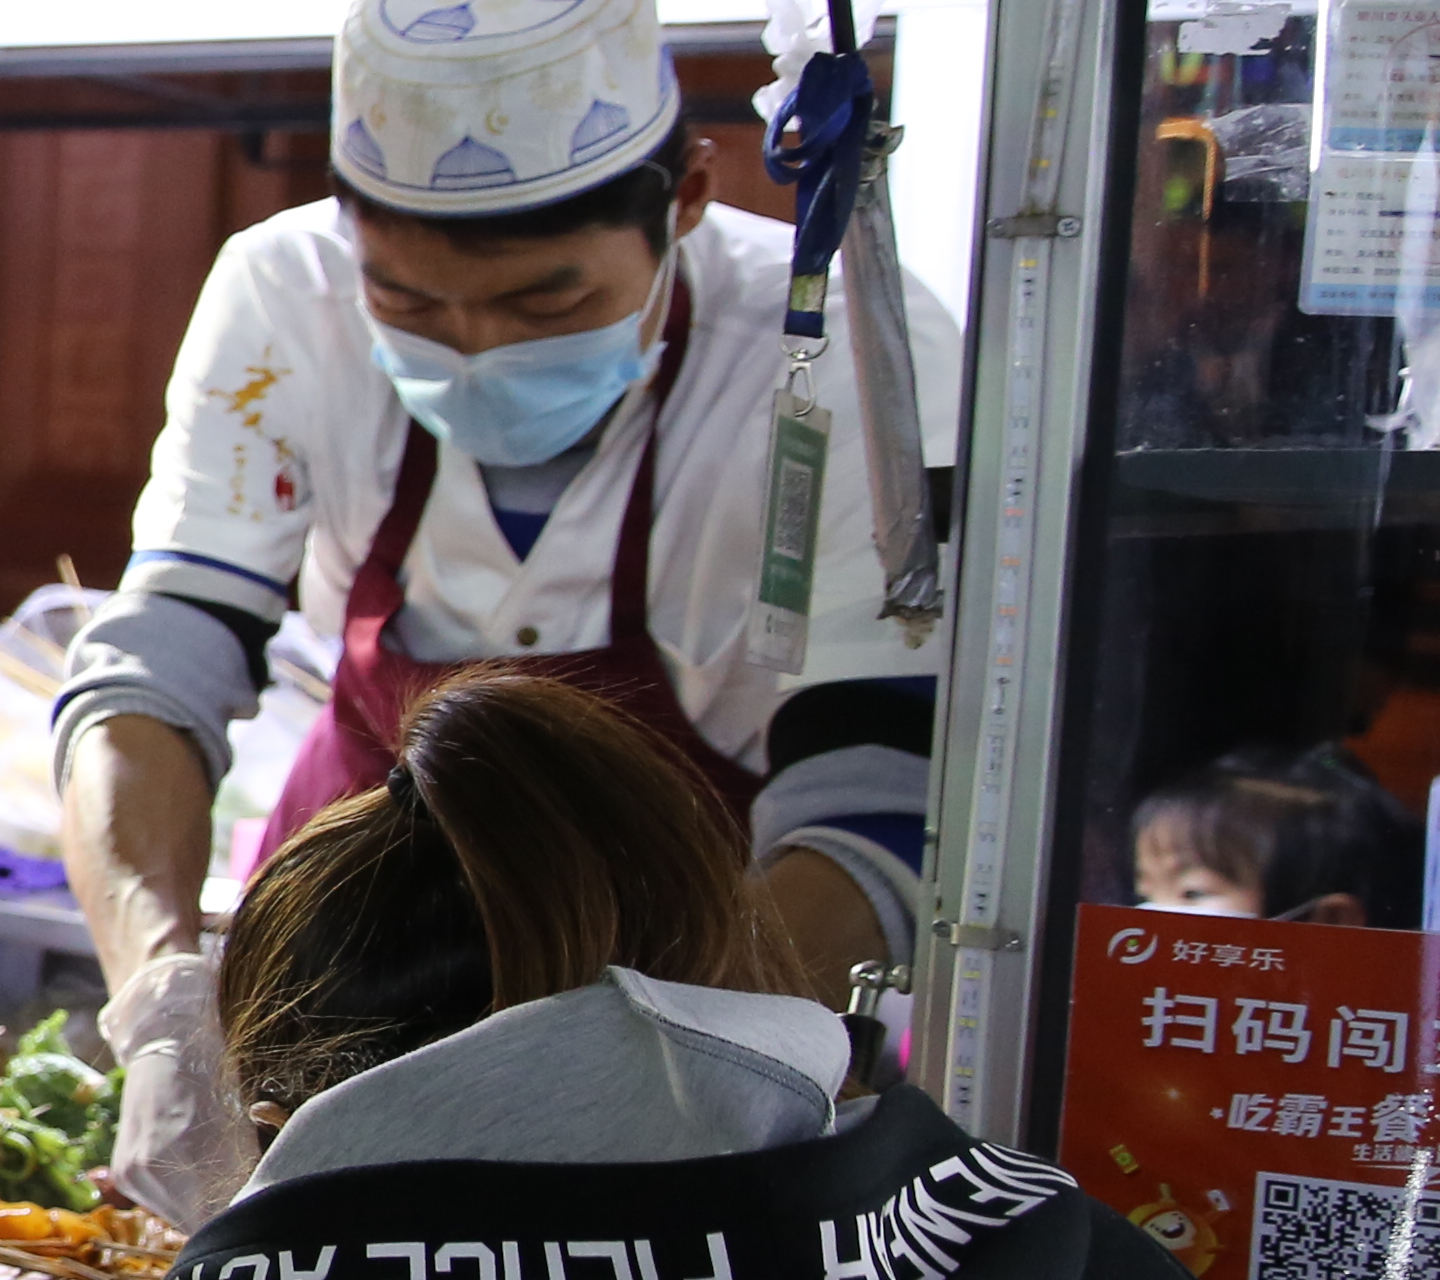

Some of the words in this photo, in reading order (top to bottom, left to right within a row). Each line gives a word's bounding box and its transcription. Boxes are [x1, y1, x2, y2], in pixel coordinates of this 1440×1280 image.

[1172, 939, 1286, 971] 好享乐
[1141, 986, 1440, 1074] 扫码闯
[1226, 1092, 1432, 1144] 吃霸王餐
